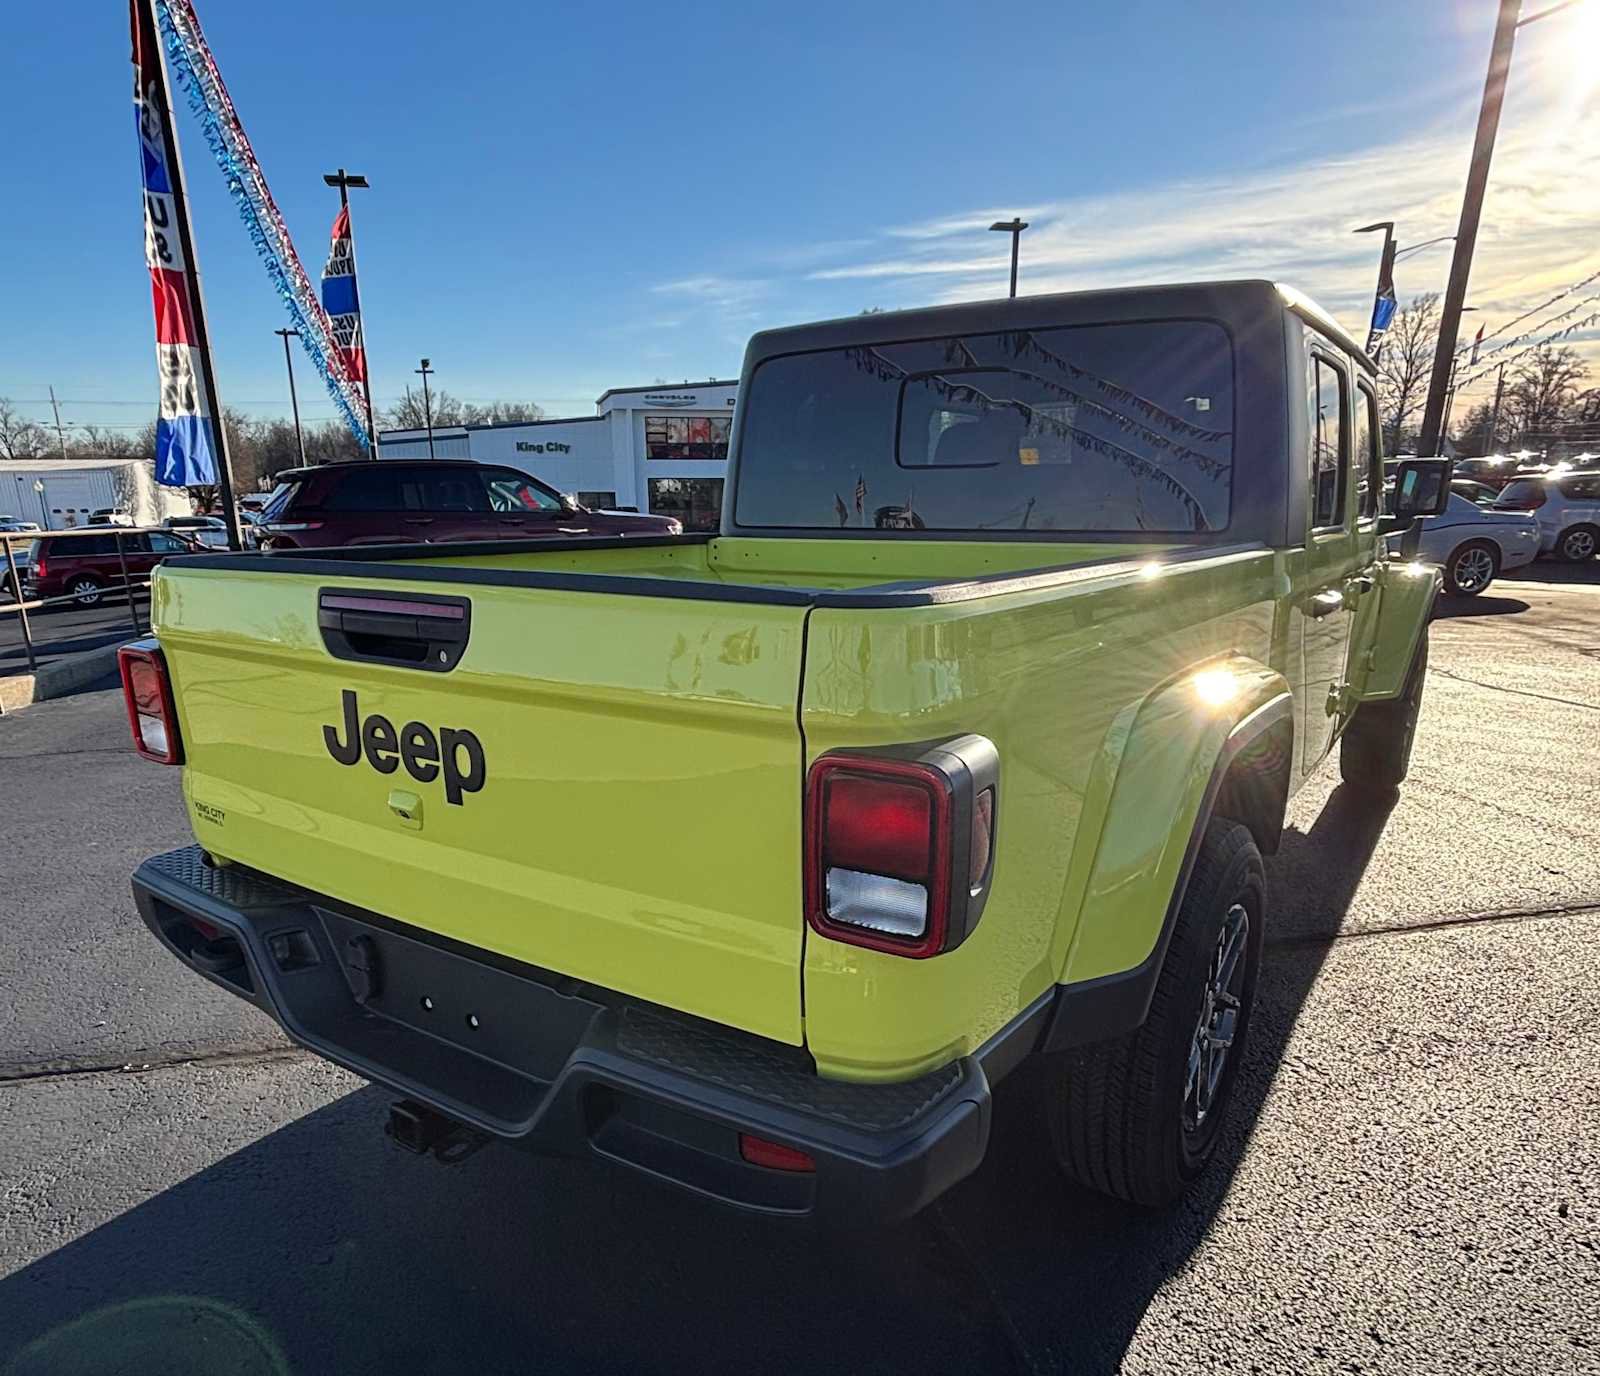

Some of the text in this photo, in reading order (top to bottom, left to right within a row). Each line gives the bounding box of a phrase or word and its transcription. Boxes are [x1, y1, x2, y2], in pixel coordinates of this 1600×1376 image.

[516, 442, 571, 454] King City
[322, 689, 487, 807] Jeep
[210, 807, 225, 821] CITY
